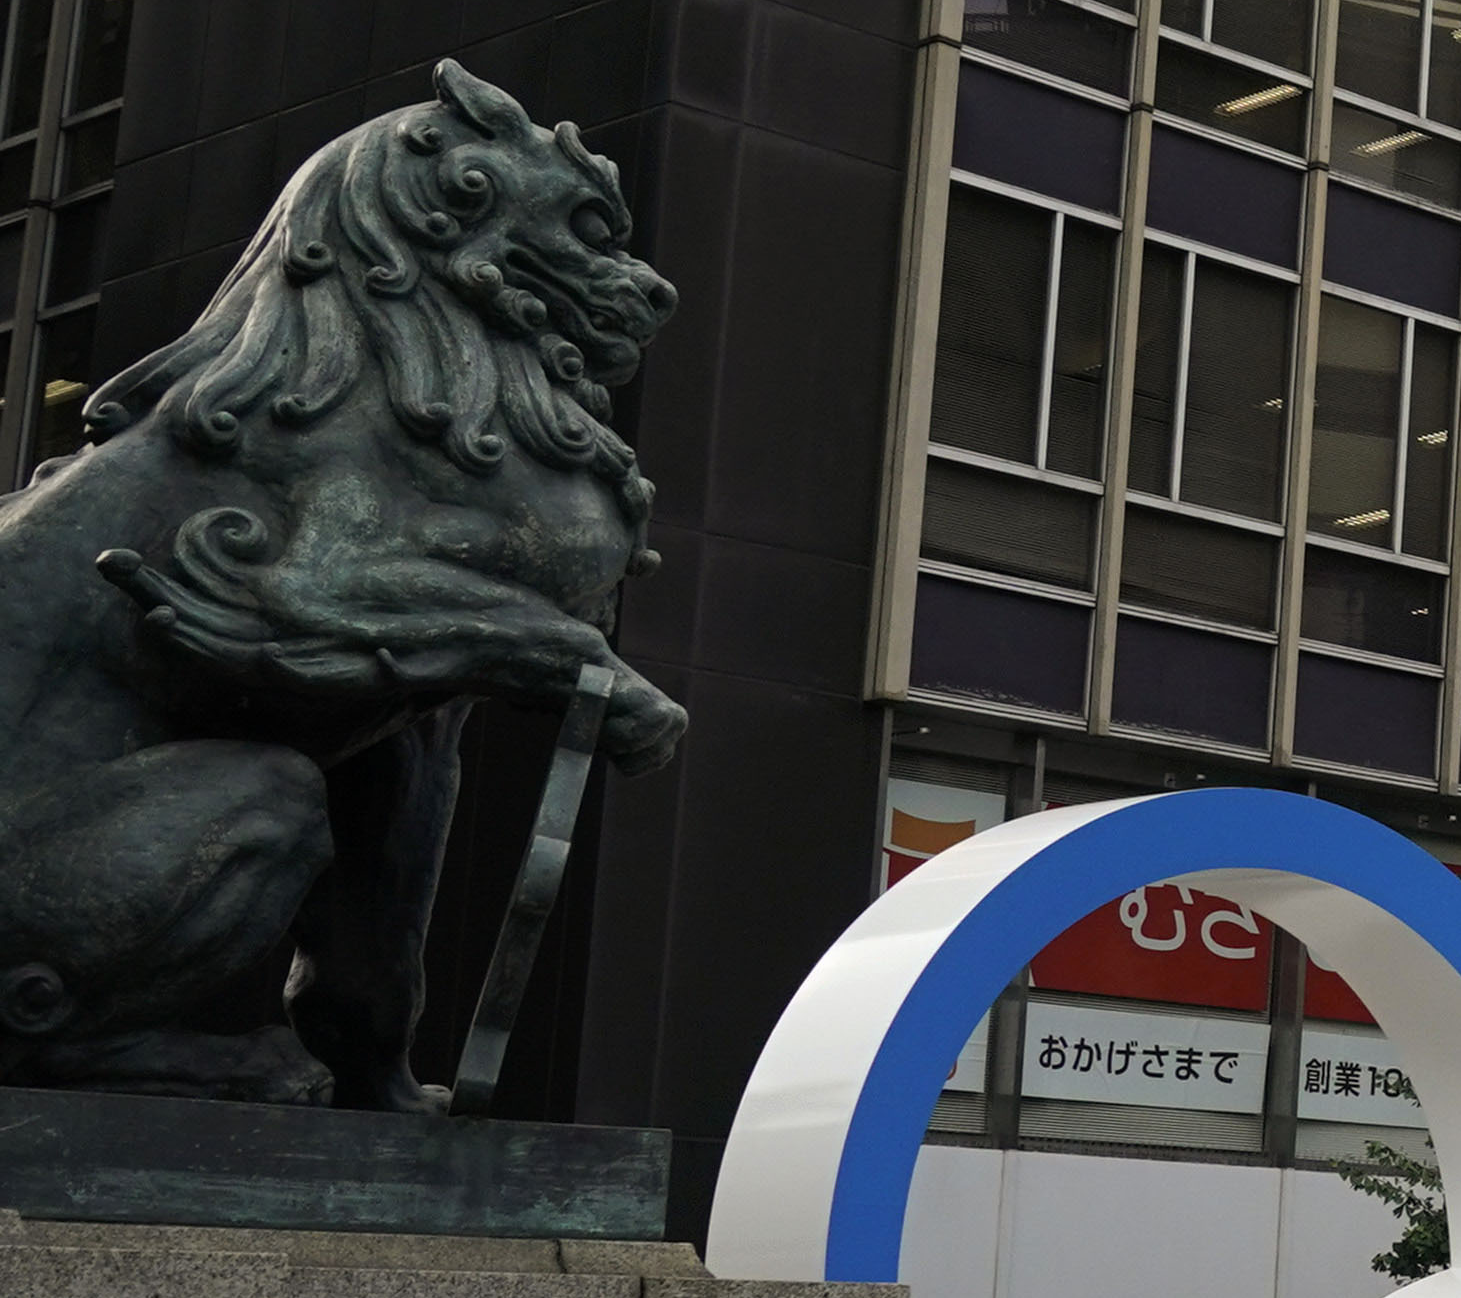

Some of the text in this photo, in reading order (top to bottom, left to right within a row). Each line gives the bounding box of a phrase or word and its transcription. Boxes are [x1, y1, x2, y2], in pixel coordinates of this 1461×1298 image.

[1037, 1033, 1241, 1086] おかげさまで
